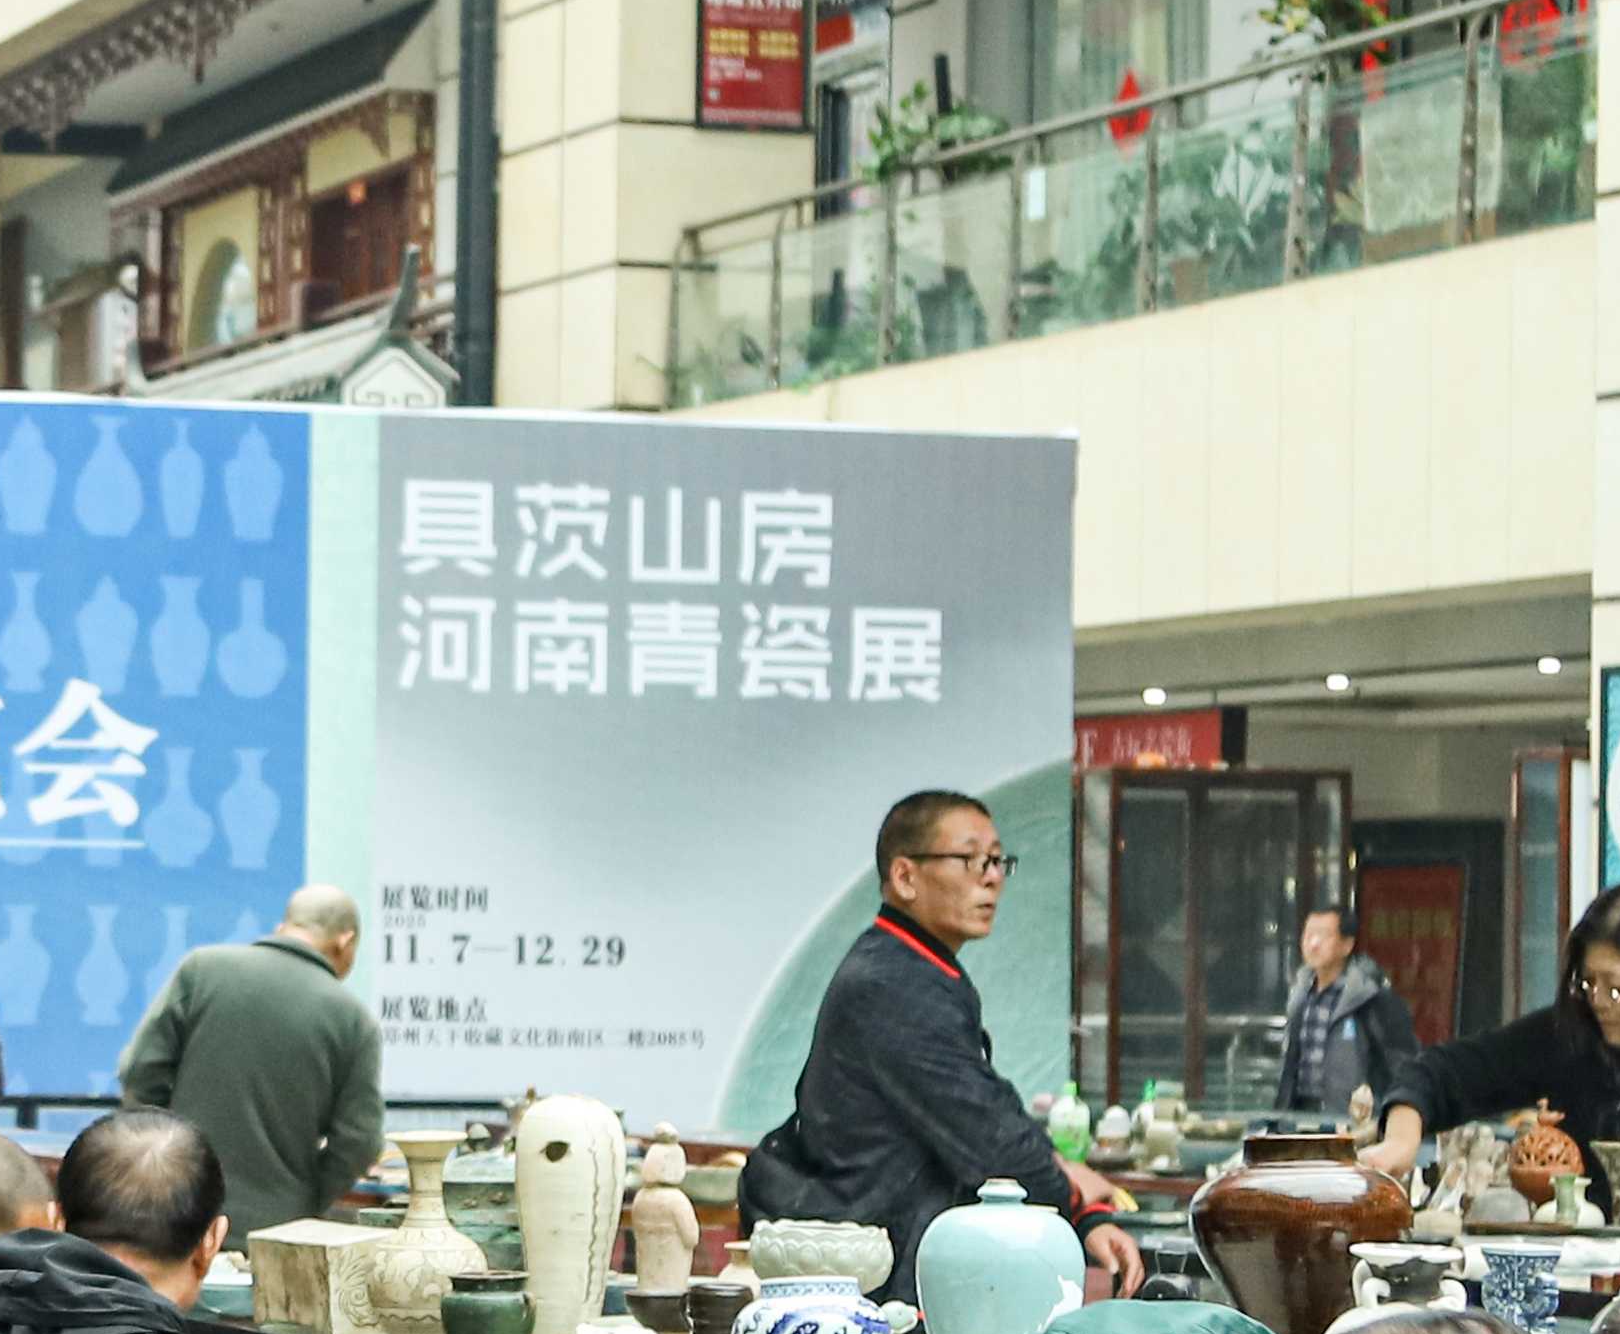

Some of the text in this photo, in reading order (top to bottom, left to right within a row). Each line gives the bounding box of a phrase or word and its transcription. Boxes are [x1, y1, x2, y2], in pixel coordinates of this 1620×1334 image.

[399, 478, 833, 588] 具茨山房
[398, 595, 943, 703] 河南青瓷展
[382, 884, 489, 913] 展览时间
[380, 996, 488, 1023] 展览地点
